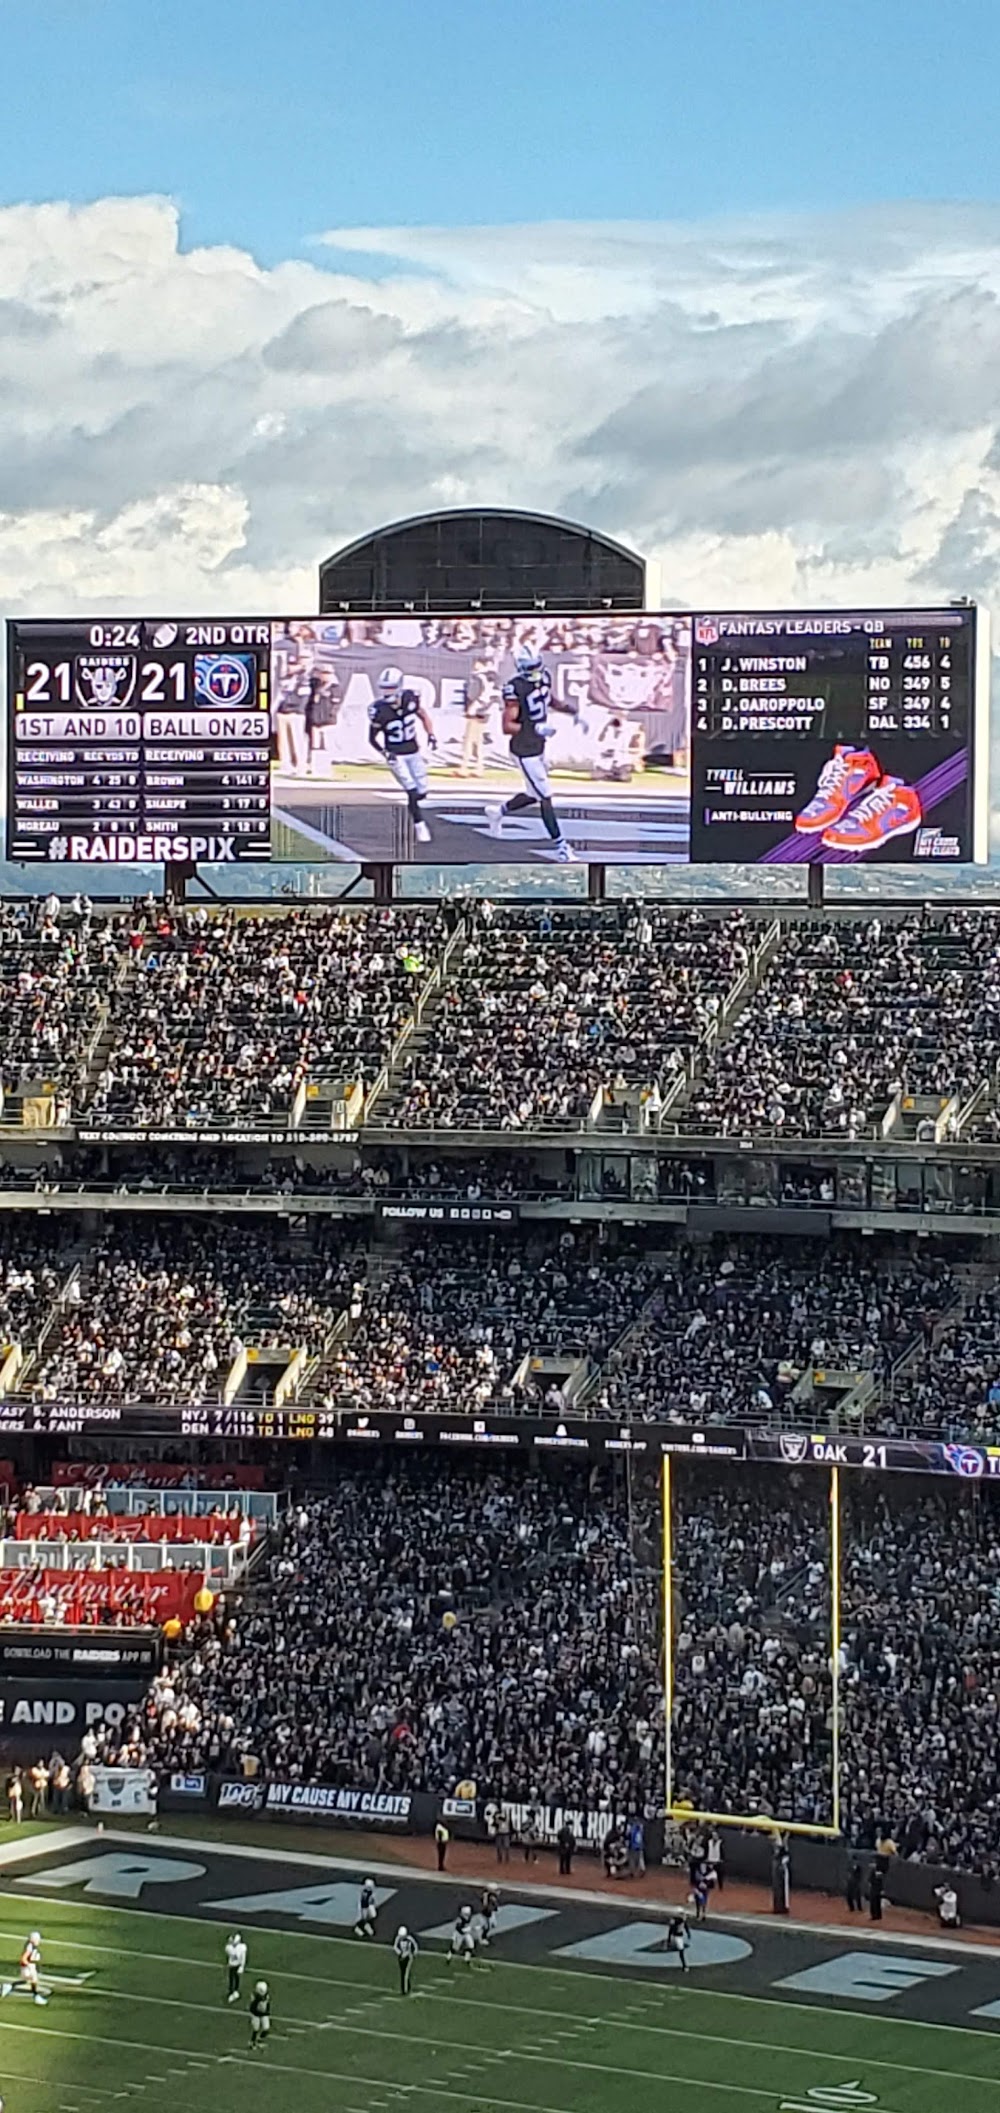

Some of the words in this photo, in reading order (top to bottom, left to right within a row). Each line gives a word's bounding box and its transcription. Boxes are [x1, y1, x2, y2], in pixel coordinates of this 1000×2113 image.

[719, 621, 785, 635] FANTASY
[786, 620, 852, 634] LEADERS
[864, 620, 885, 633] QB
[90, 625, 140, 647] 0:24
[186, 626, 226, 645] 2ND
[230, 626, 270, 645] QTR
[698, 658, 707, 671] 1
[869, 655, 890, 670] TB
[903, 655, 931, 669] 456
[940, 654, 951, 670] 4
[27, 662, 71, 701] 21
[141, 662, 186, 701] 21
[697, 677, 708, 692] 2
[869, 676, 891, 690] NO
[903, 676, 931, 690] 349
[940, 676, 951, 690] 5
[697, 697, 708, 712] 3
[868, 696, 888, 710] SF
[903, 696, 931, 710] 349
[940, 696, 951, 710] 4
[19, 719, 55, 735] 1ST
[64, 719, 106, 735] AND
[115, 719, 137, 735] 10
[151, 719, 202, 735] BALL
[208, 719, 237, 735] ON
[243, 719, 264, 735] 25
[697, 716, 708, 730] 4
[869, 715, 899, 729] DAL
[903, 715, 931, 729] 334
[940, 715, 949, 729] 1
[17, 751, 75, 762] RECEIVING
[145, 751, 205, 761] RECEIVING
[17, 775, 85, 786] WASHINGTON
[92, 775, 101, 785] 4
[146, 775, 184, 786] BROWN
[221, 775, 230, 785] 4
[236, 775, 252, 785] 141
[258, 775, 266, 785] 2
[706, 769, 744, 781] TYRELL
[724, 781, 796, 795] WILLIAMS
[17, 799, 59, 810] WALLER
[222, 798, 230, 809] 3
[237, 798, 250, 809] 17
[711, 810, 793, 821] ANTI-BULLYING
[92, 821, 101, 832] 2
[129, 821, 135, 832] 1
[145, 821, 179, 832] SMITH
[222, 821, 230, 832] 2
[237, 821, 250, 832] 12
[49, 835, 236, 861] #RAIDERSPIX
[271, 1133, 284, 1142] TO
[382, 1206, 427, 1217] FOLLOW
[429, 1207, 444, 1218] US
[49, 1407, 121, 1419] ANDERSON
[182, 1410, 208, 1421] NYJ
[258, 1412, 273, 1423] TD
[278, 1412, 283, 1423] 1
[49, 1420, 84, 1432] FANT
[182, 1422, 209, 1434] DEN
[258, 1425, 273, 1436] TD
[278, 1425, 283, 1436] 1
[813, 1443, 848, 1462] OAK
[862, 1445, 887, 1469] 21
[987, 1456, 1000, 1473] T
[4, 1647, 52, 1659] DOWNLOAD
[55, 1648, 71, 1660] THE
[73, 1649, 120, 1662] RAIDERS
[122, 1651, 139, 1662] APP
[11, 1700, 76, 1724] AND
[268, 1783, 292, 1804] MY
[292, 1786, 335, 1808] CAUSE
[337, 1791, 360, 1811] MY
[361, 1793, 411, 1816] CLEATS
